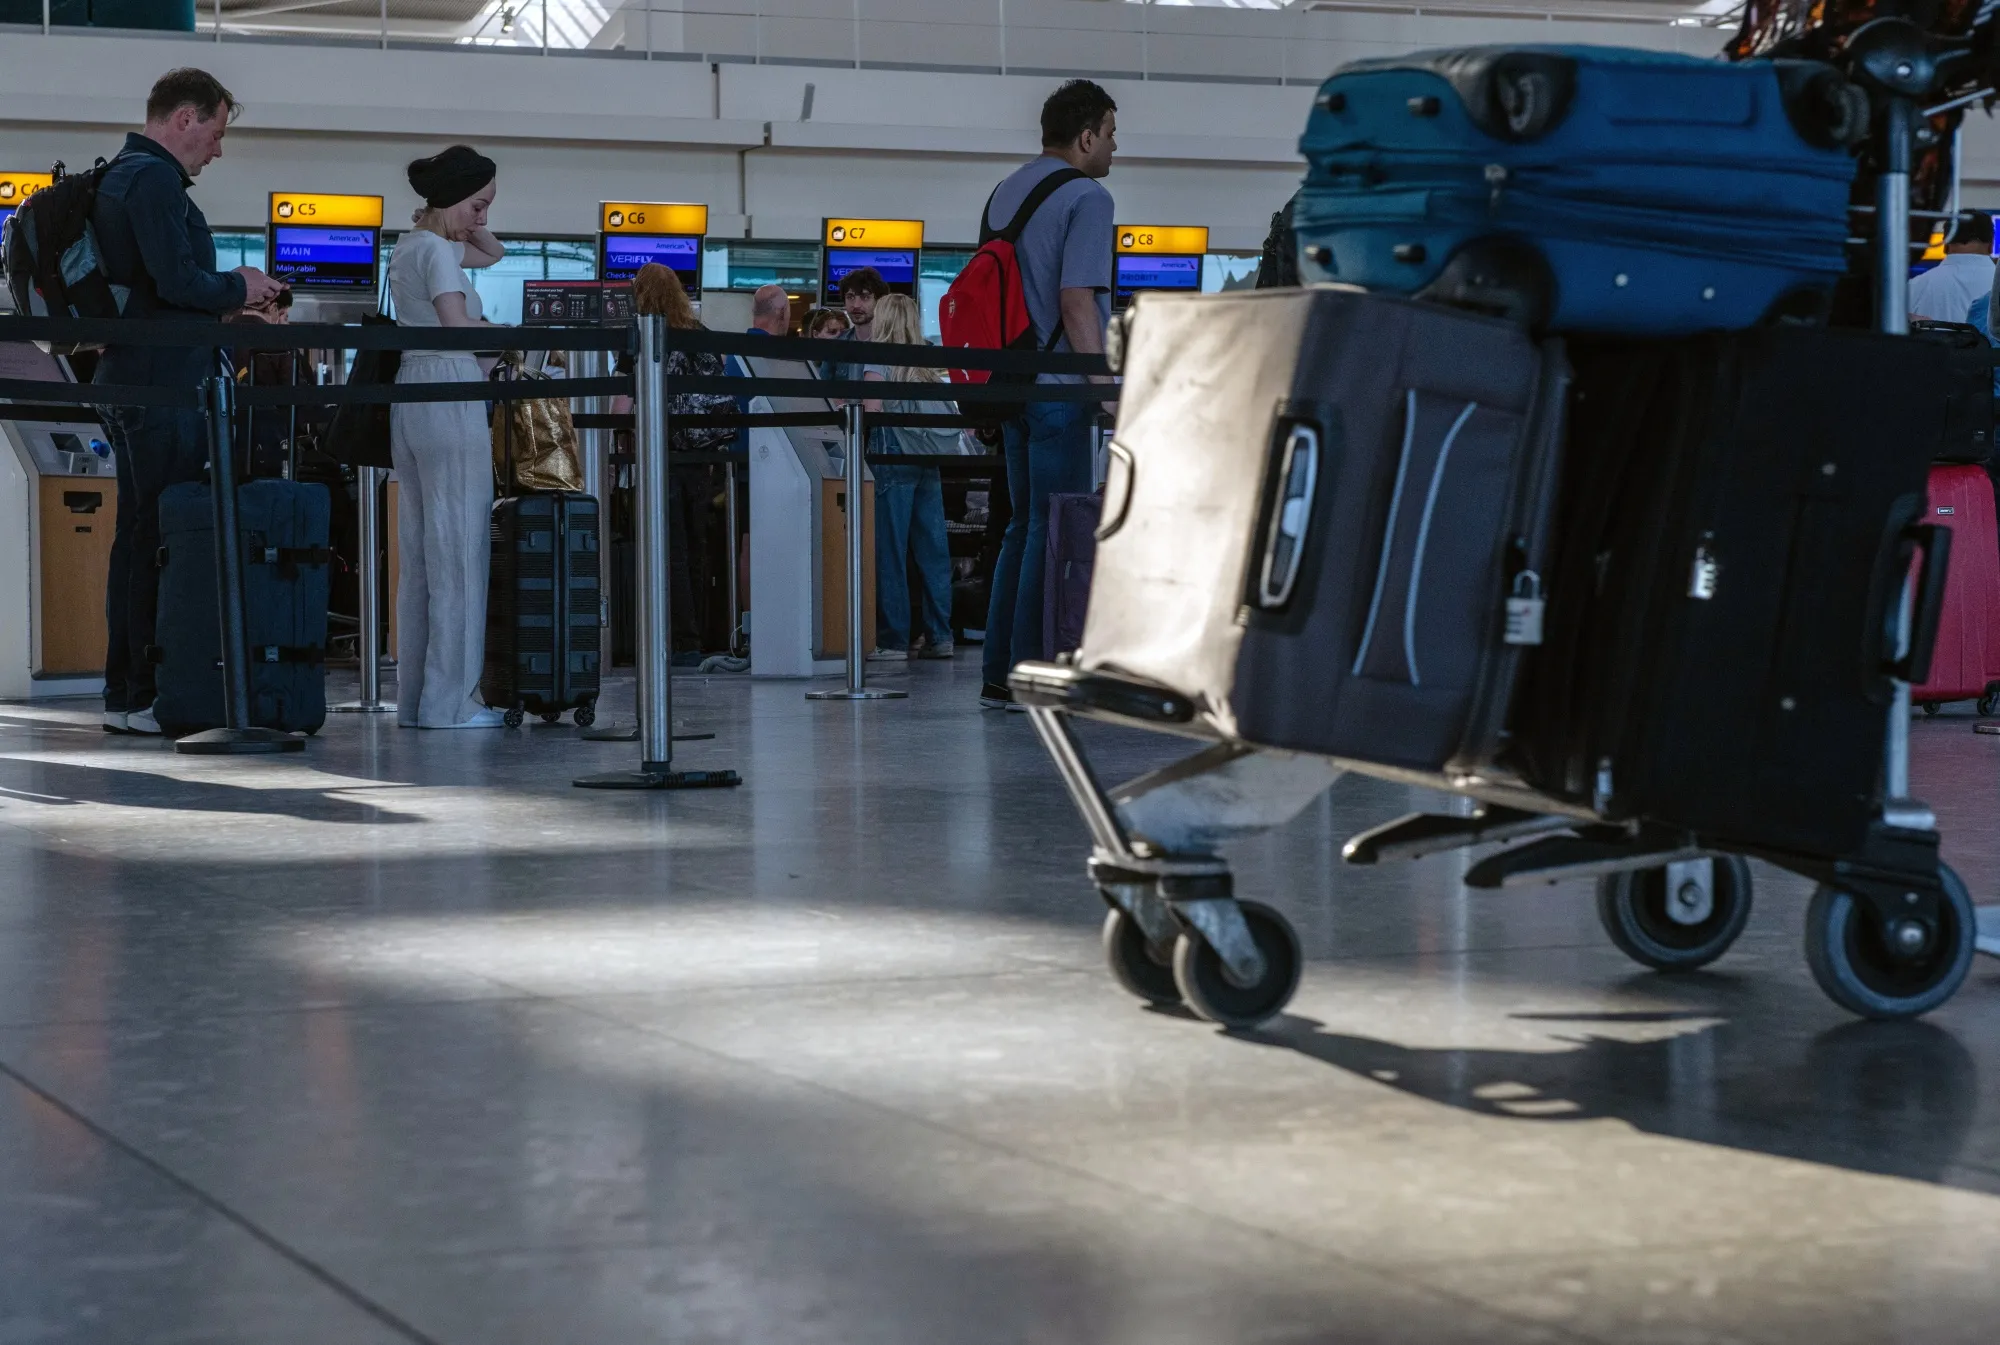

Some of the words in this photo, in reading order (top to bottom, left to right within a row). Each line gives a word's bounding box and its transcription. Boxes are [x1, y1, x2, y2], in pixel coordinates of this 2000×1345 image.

[298, 203, 316, 216] C5
[628, 212, 645, 224] C6
[849, 227, 866, 239] C7
[1138, 234, 1154, 245] C8
[280, 247, 311, 256] MAIN
[610, 254, 654, 264] VERIFLY
[276, 264, 295, 272] Main
[606, 271, 635, 279] Check-in
[1121, 273, 1158, 281] PRIORITY
